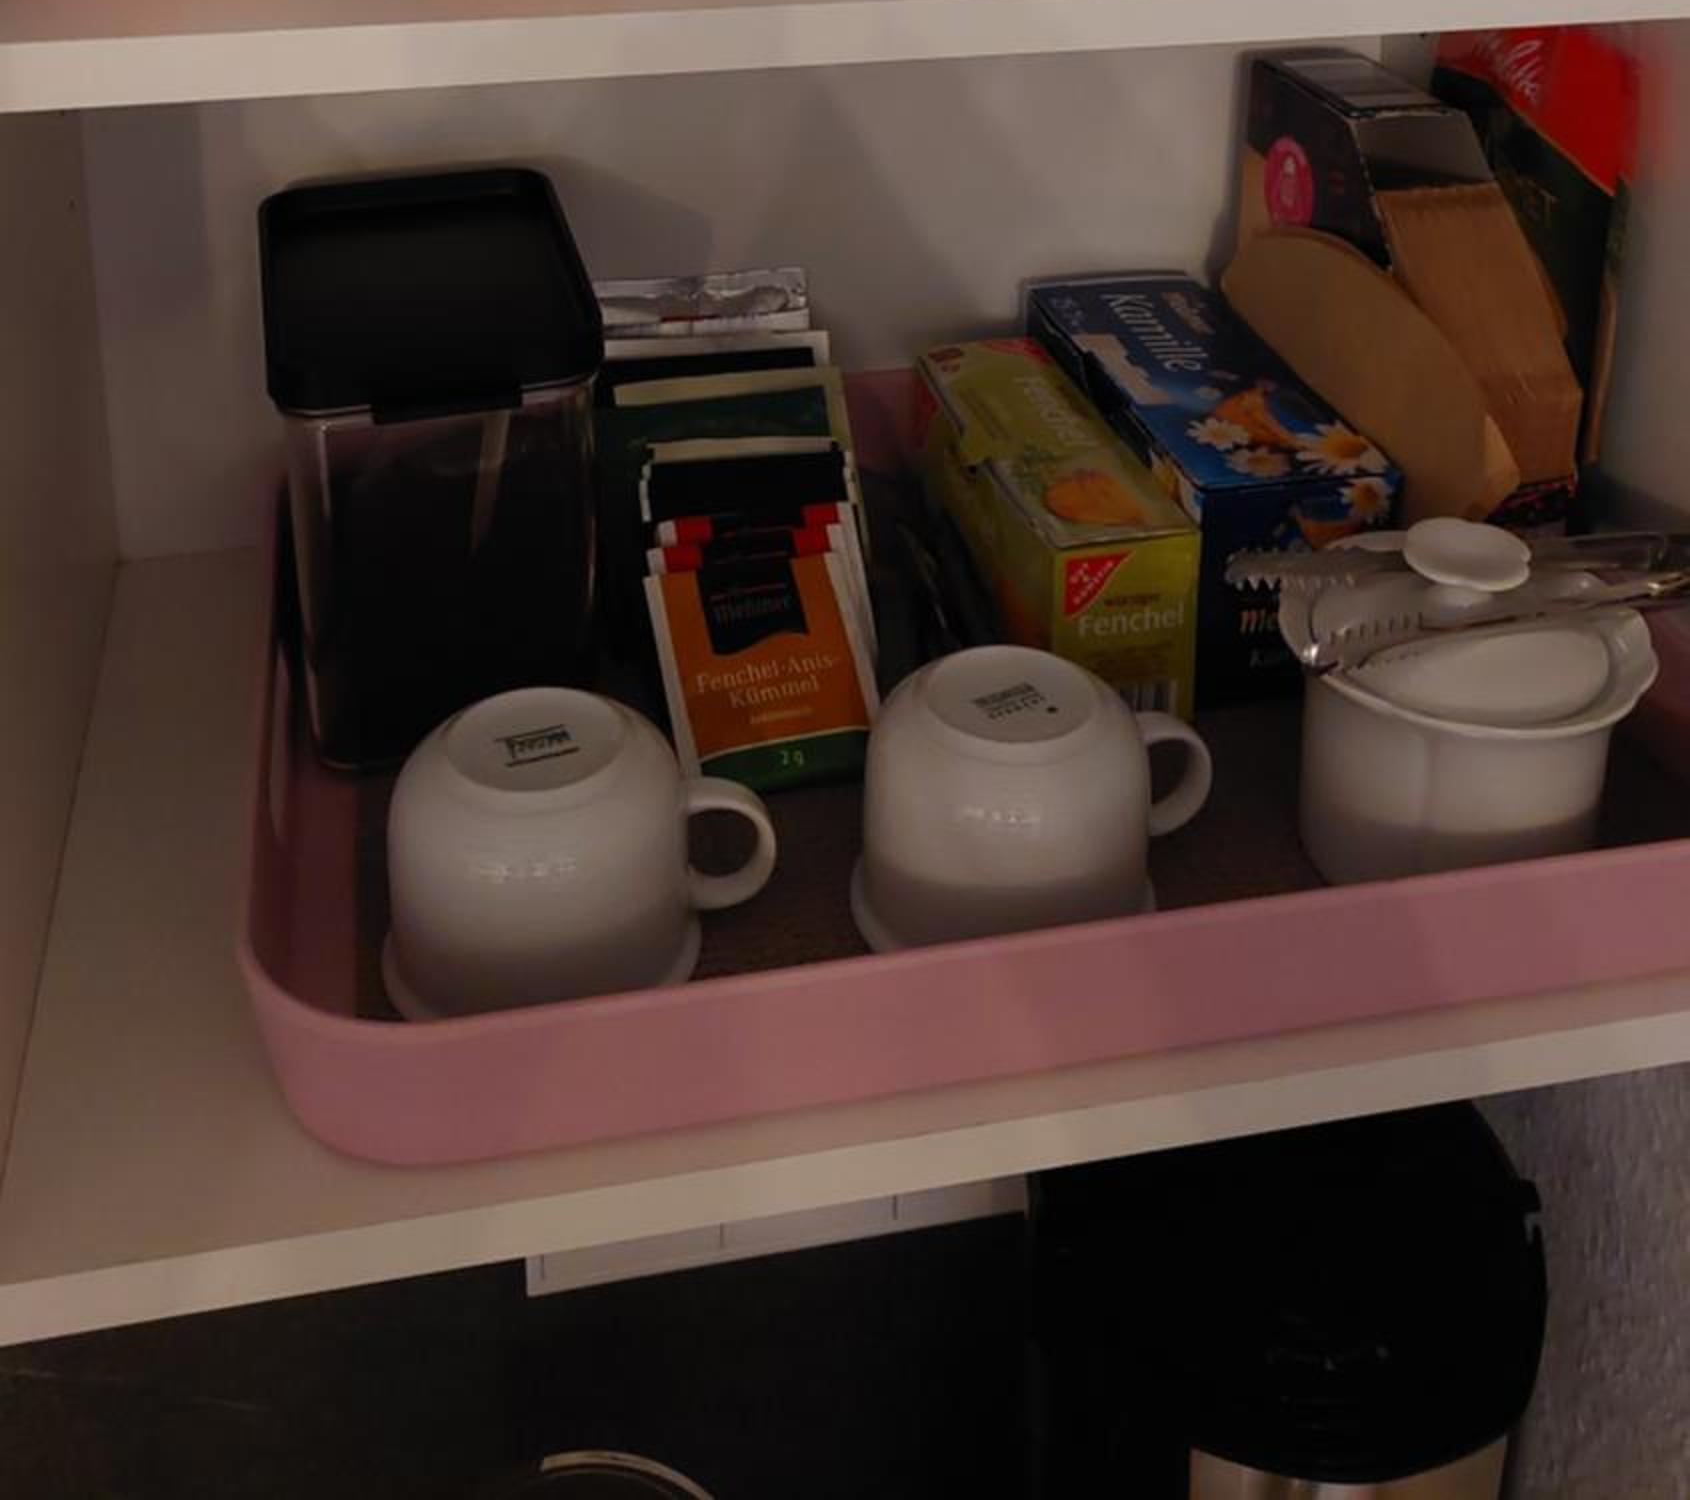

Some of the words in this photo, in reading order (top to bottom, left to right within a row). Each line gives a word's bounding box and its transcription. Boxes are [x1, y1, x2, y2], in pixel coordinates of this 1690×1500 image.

[1098, 292, 1209, 372] Kamille
[1077, 603, 1185, 638] Fenchel
[728, 674, 820, 709] Kümmel
